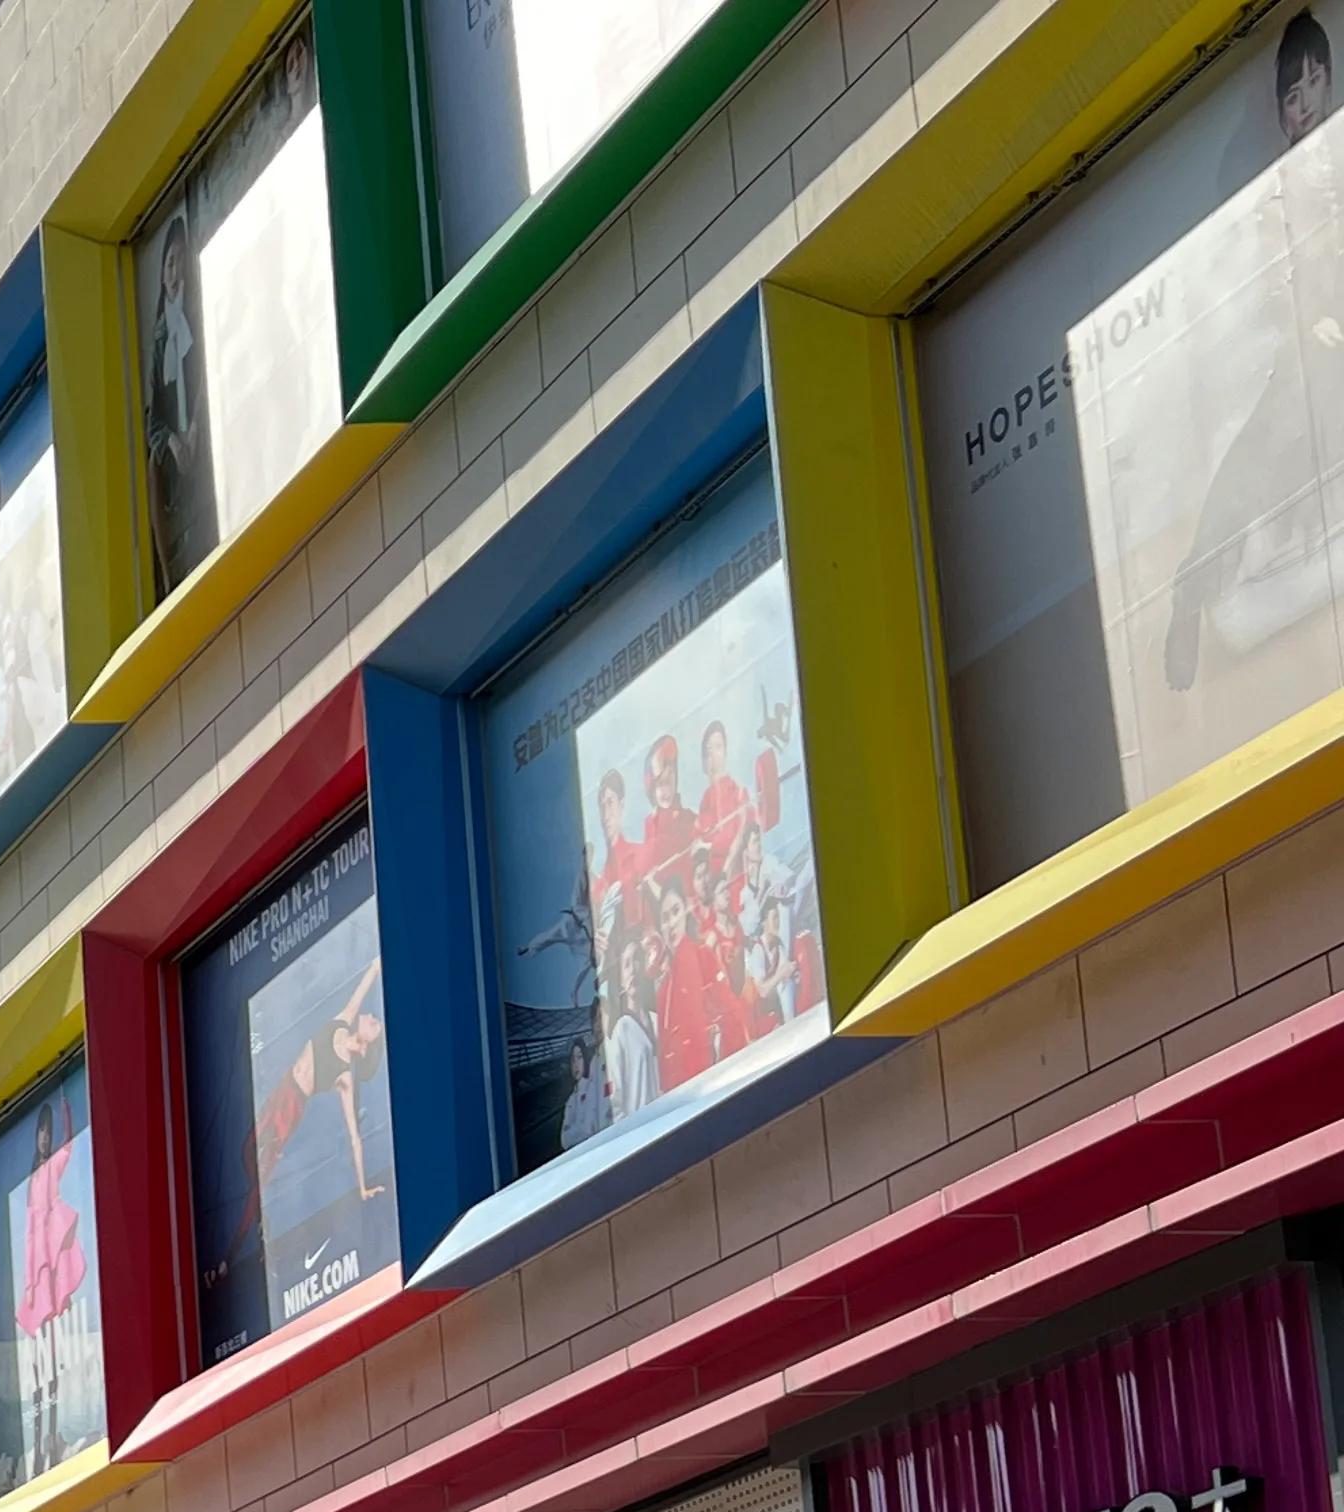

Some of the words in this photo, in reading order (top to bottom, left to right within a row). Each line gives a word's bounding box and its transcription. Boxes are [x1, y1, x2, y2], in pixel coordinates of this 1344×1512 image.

[965, 278, 1166, 466] HOPESHOW
[229, 918, 260, 967] NIKE
[261, 894, 290, 940] PRO
[291, 860, 331, 915] N+TC
[331, 826, 371, 880] TOUR
[270, 895, 330, 963] SHANGHAI
[283, 1249, 361, 1320] NIKE.COM
